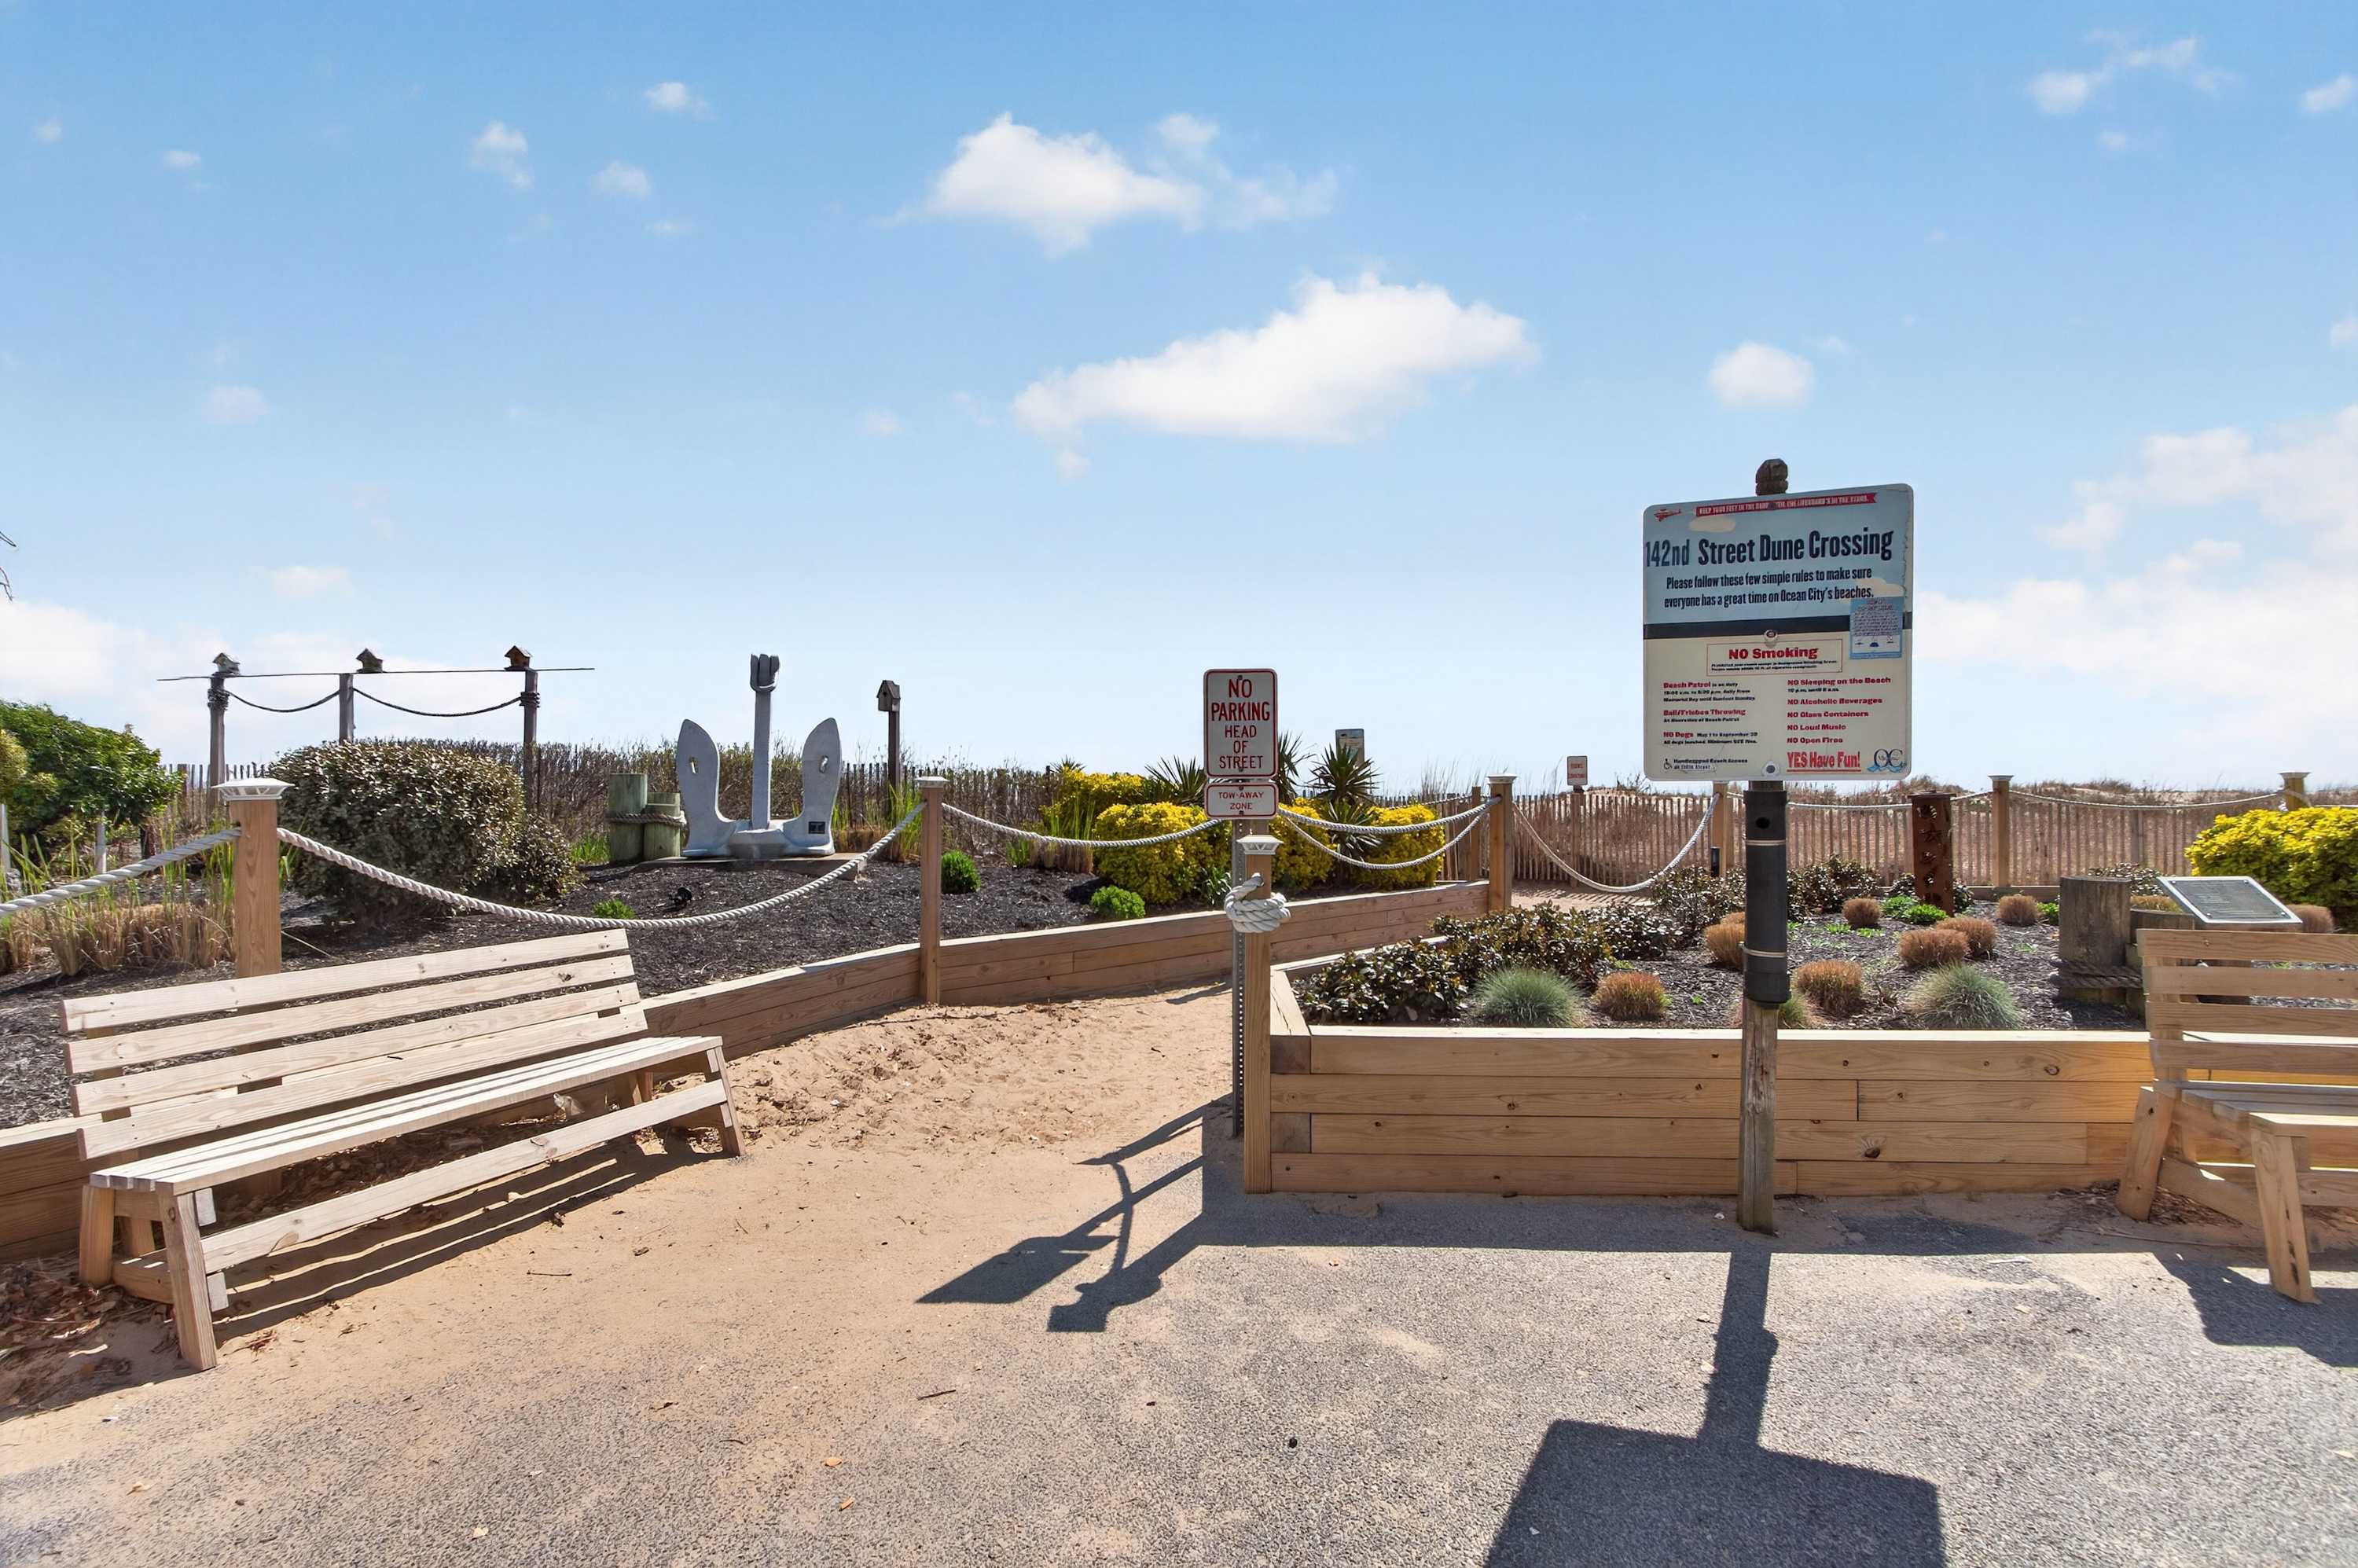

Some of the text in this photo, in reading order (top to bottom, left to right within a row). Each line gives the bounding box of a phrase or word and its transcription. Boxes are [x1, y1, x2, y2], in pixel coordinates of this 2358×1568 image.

[1646, 527, 1893, 567] 142nd Street Dune Crossing
[1666, 567, 1872, 589] Please follow these few simple rules to make sure
[1664, 586, 1874, 610] everyone has a great time on Ocean City's beaches.
[1729, 647, 1819, 659] NO Smoking
[1229, 679, 1252, 698] NO
[1211, 702, 1270, 722] PARKING
[1225, 725, 1257, 738] HEAD
[1233, 740, 1248, 753] OF
[1219, 755, 1263, 769] STREET
[1787, 751, 1860, 768] YES Have Fun!
